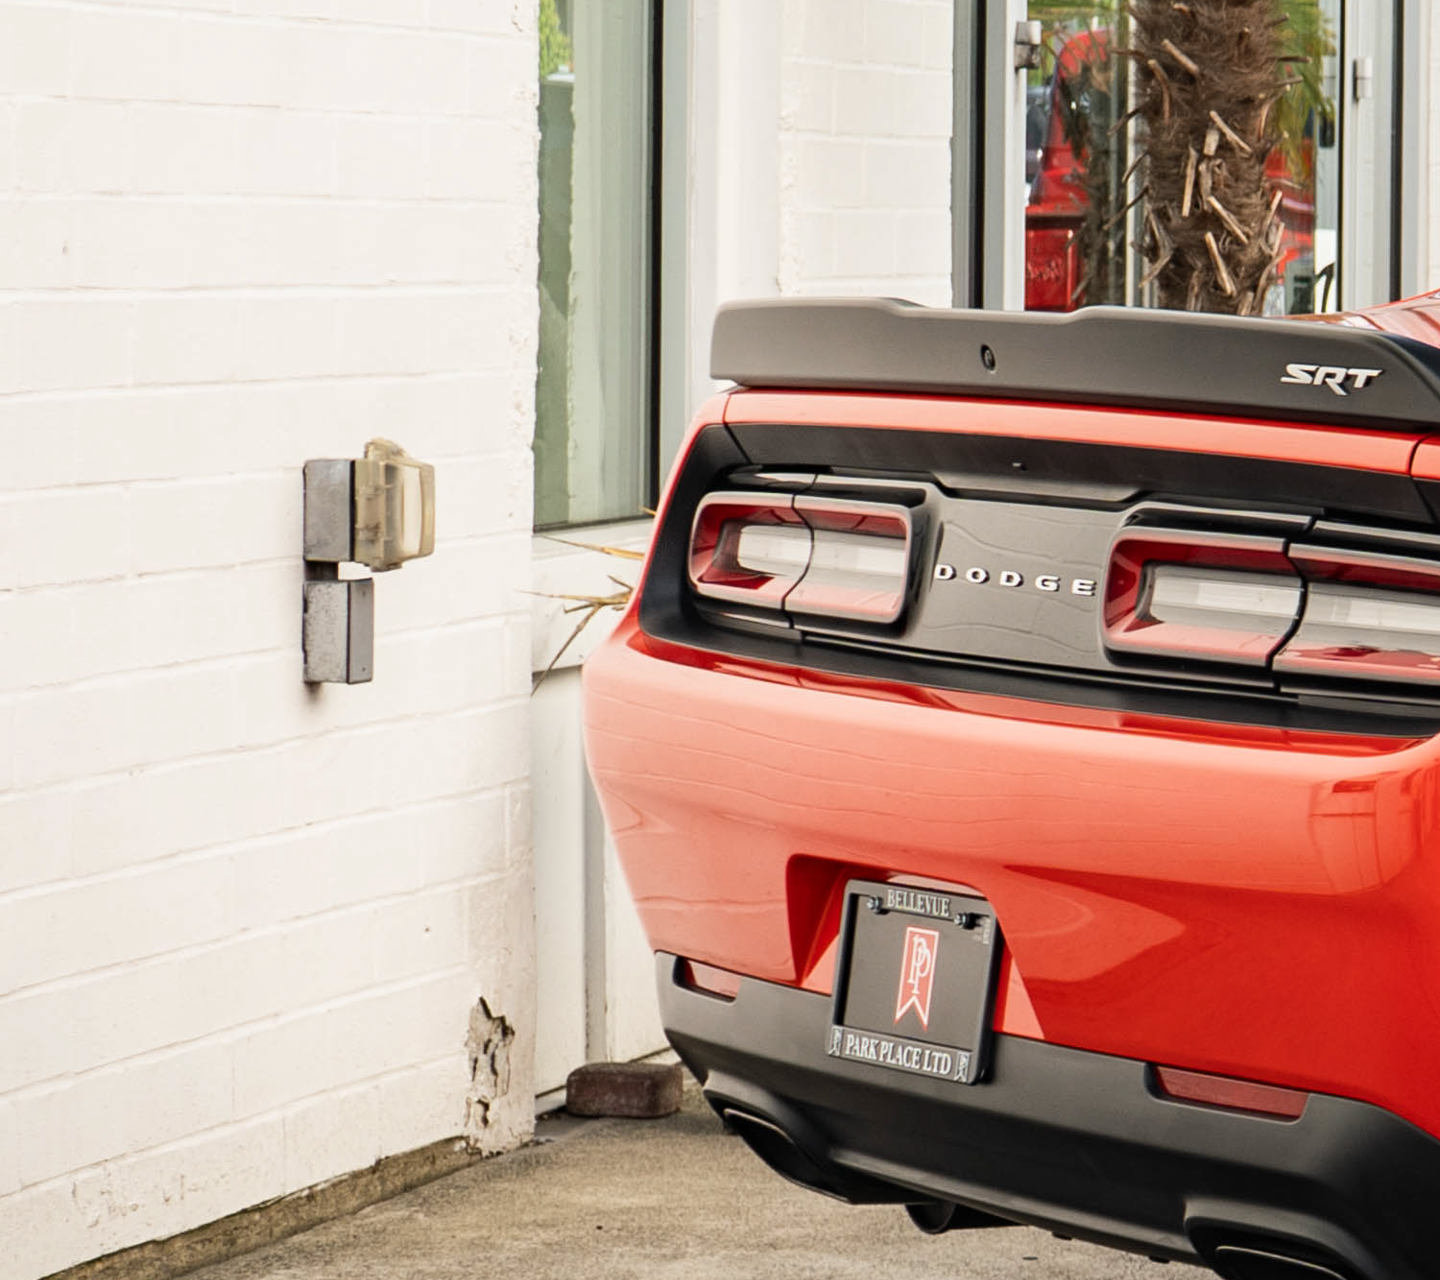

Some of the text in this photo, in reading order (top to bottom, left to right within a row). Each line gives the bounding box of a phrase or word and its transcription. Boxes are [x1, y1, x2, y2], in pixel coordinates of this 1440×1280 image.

[1280, 363, 1383, 396] SRT
[934, 563, 1097, 597] DODGE
[887, 889, 950, 917] BELLEVUE
[845, 1034, 878, 1060] PARK
[880, 1041, 922, 1070] PLACE
[922, 1050, 952, 1076] LTD
